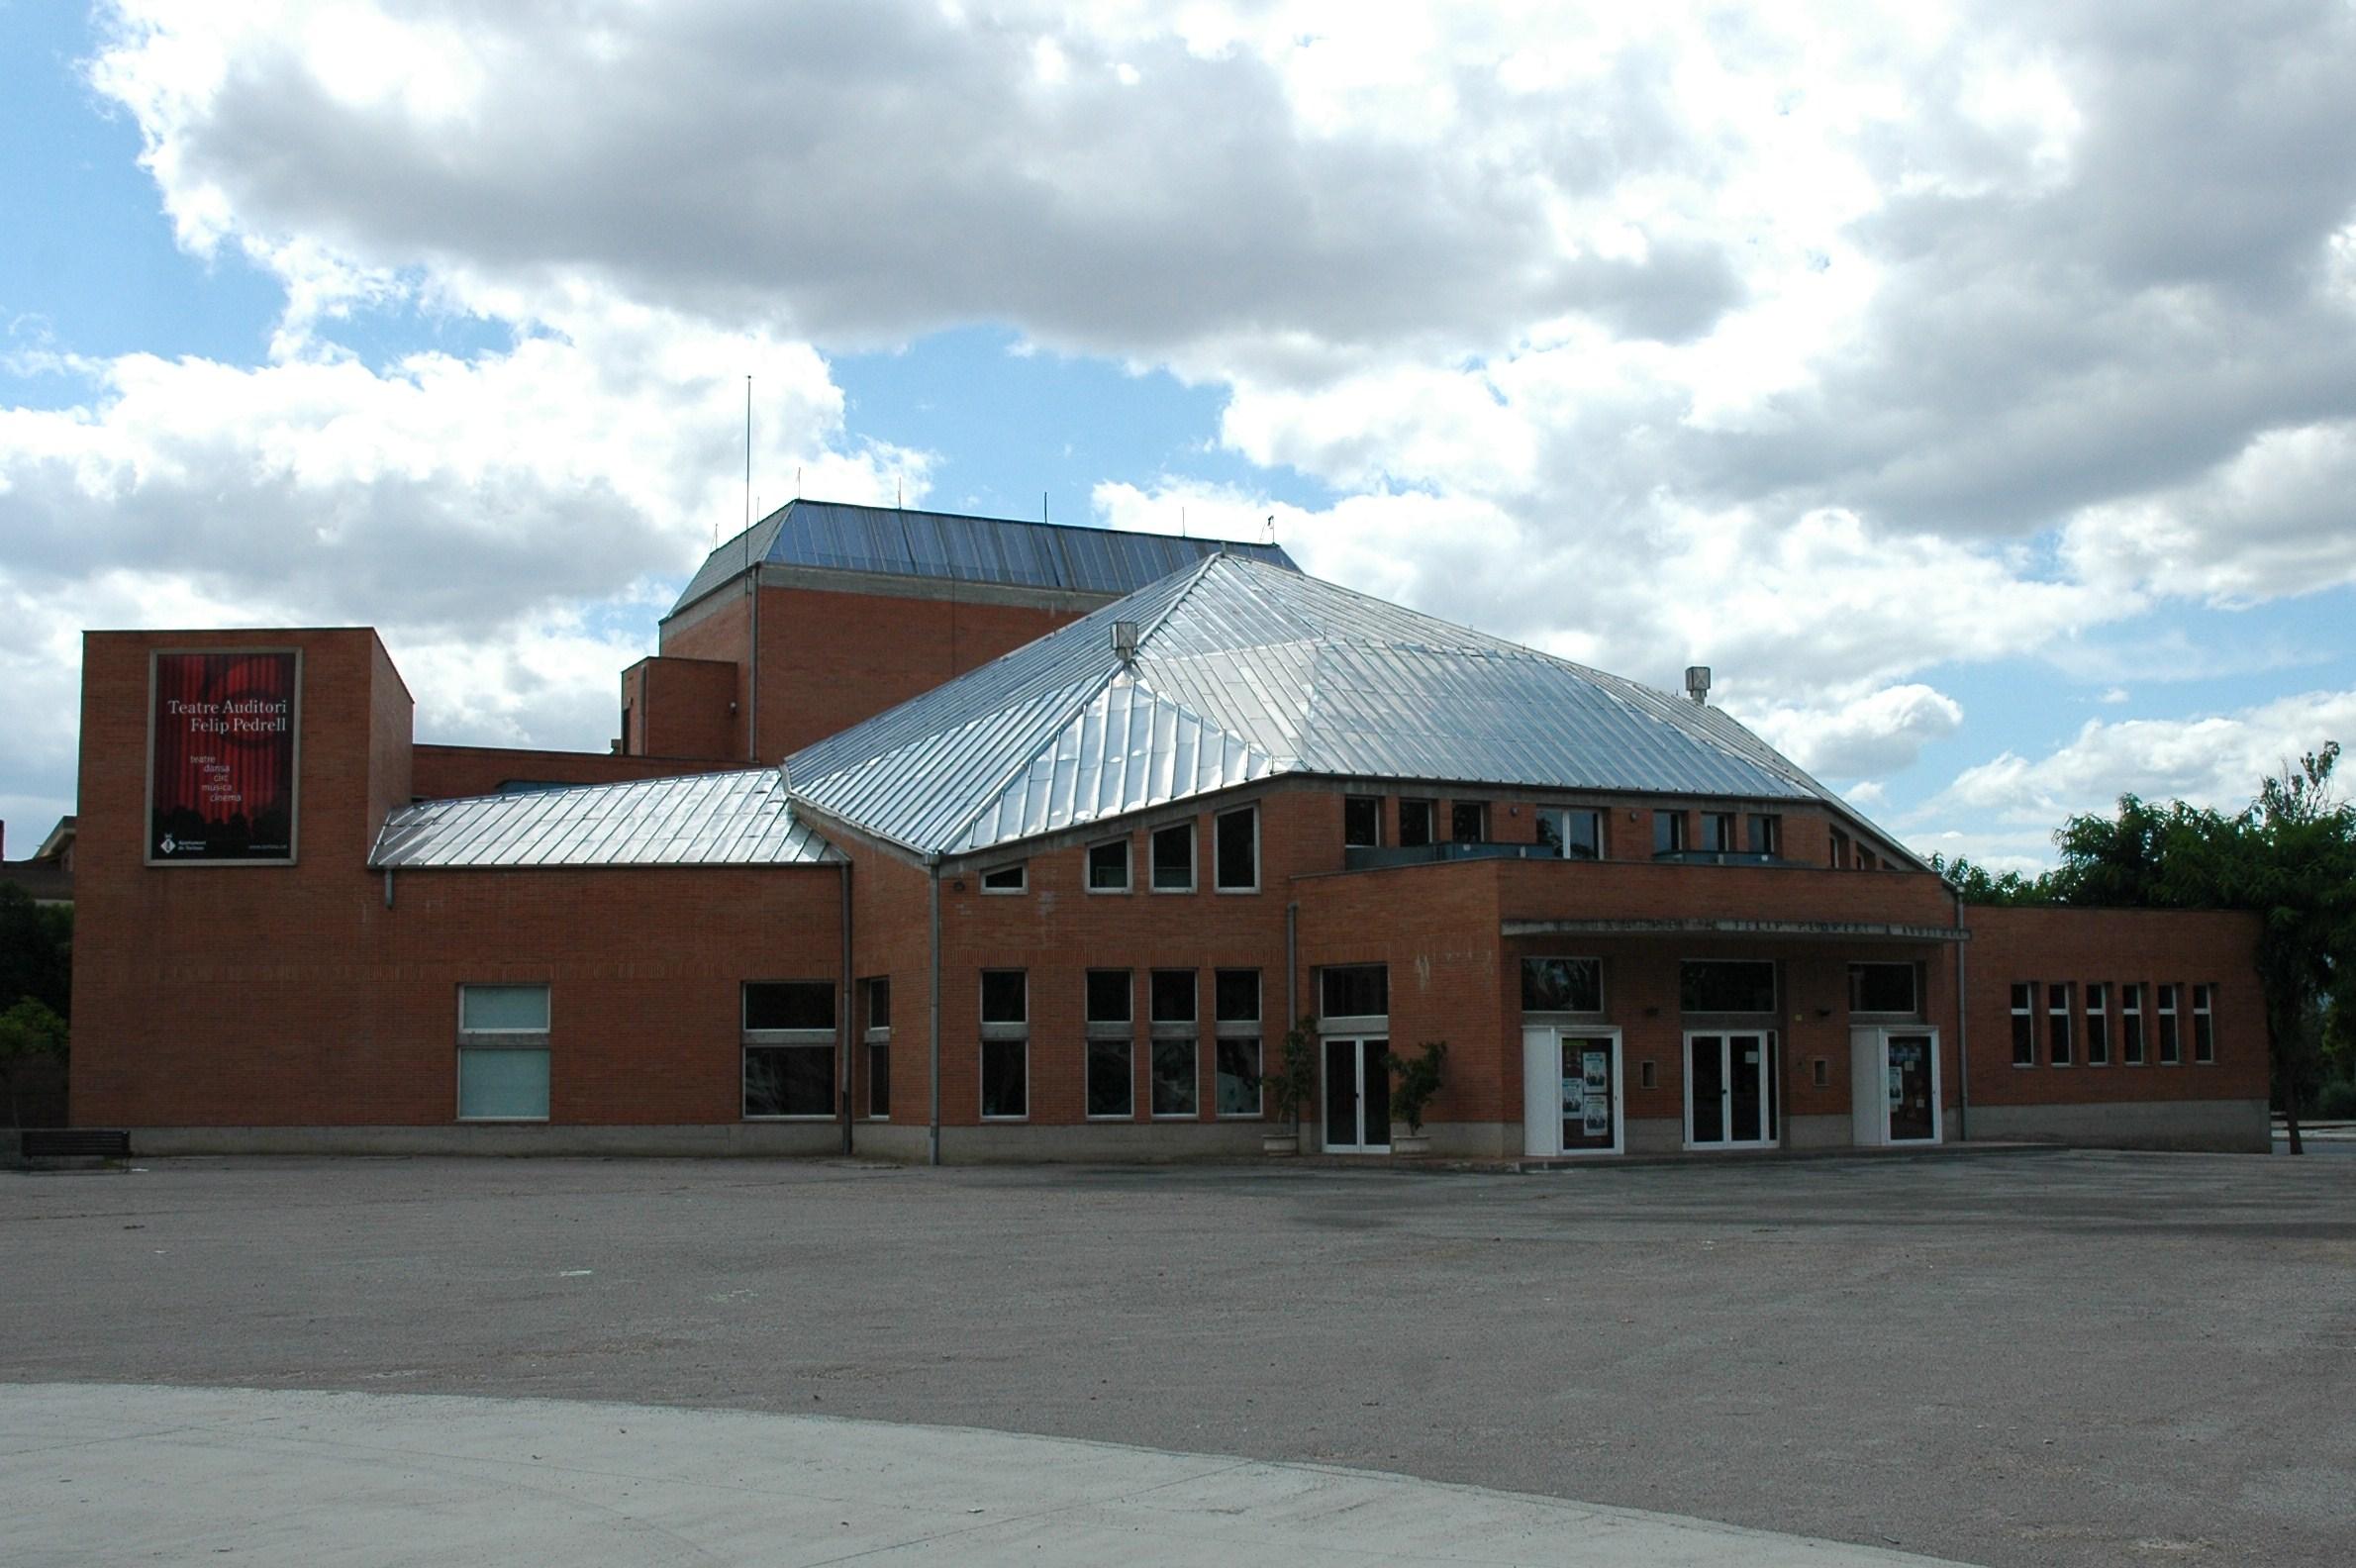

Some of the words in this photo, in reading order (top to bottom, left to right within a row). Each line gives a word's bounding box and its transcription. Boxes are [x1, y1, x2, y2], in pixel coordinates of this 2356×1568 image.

[166, 699, 219, 714] Teatre
[222, 698, 288, 714] Auditori
[190, 717, 230, 735] Felip
[233, 717, 287, 733] Pedrell
[190, 754, 216, 763] teatre
[210, 793, 242, 802] cinema
